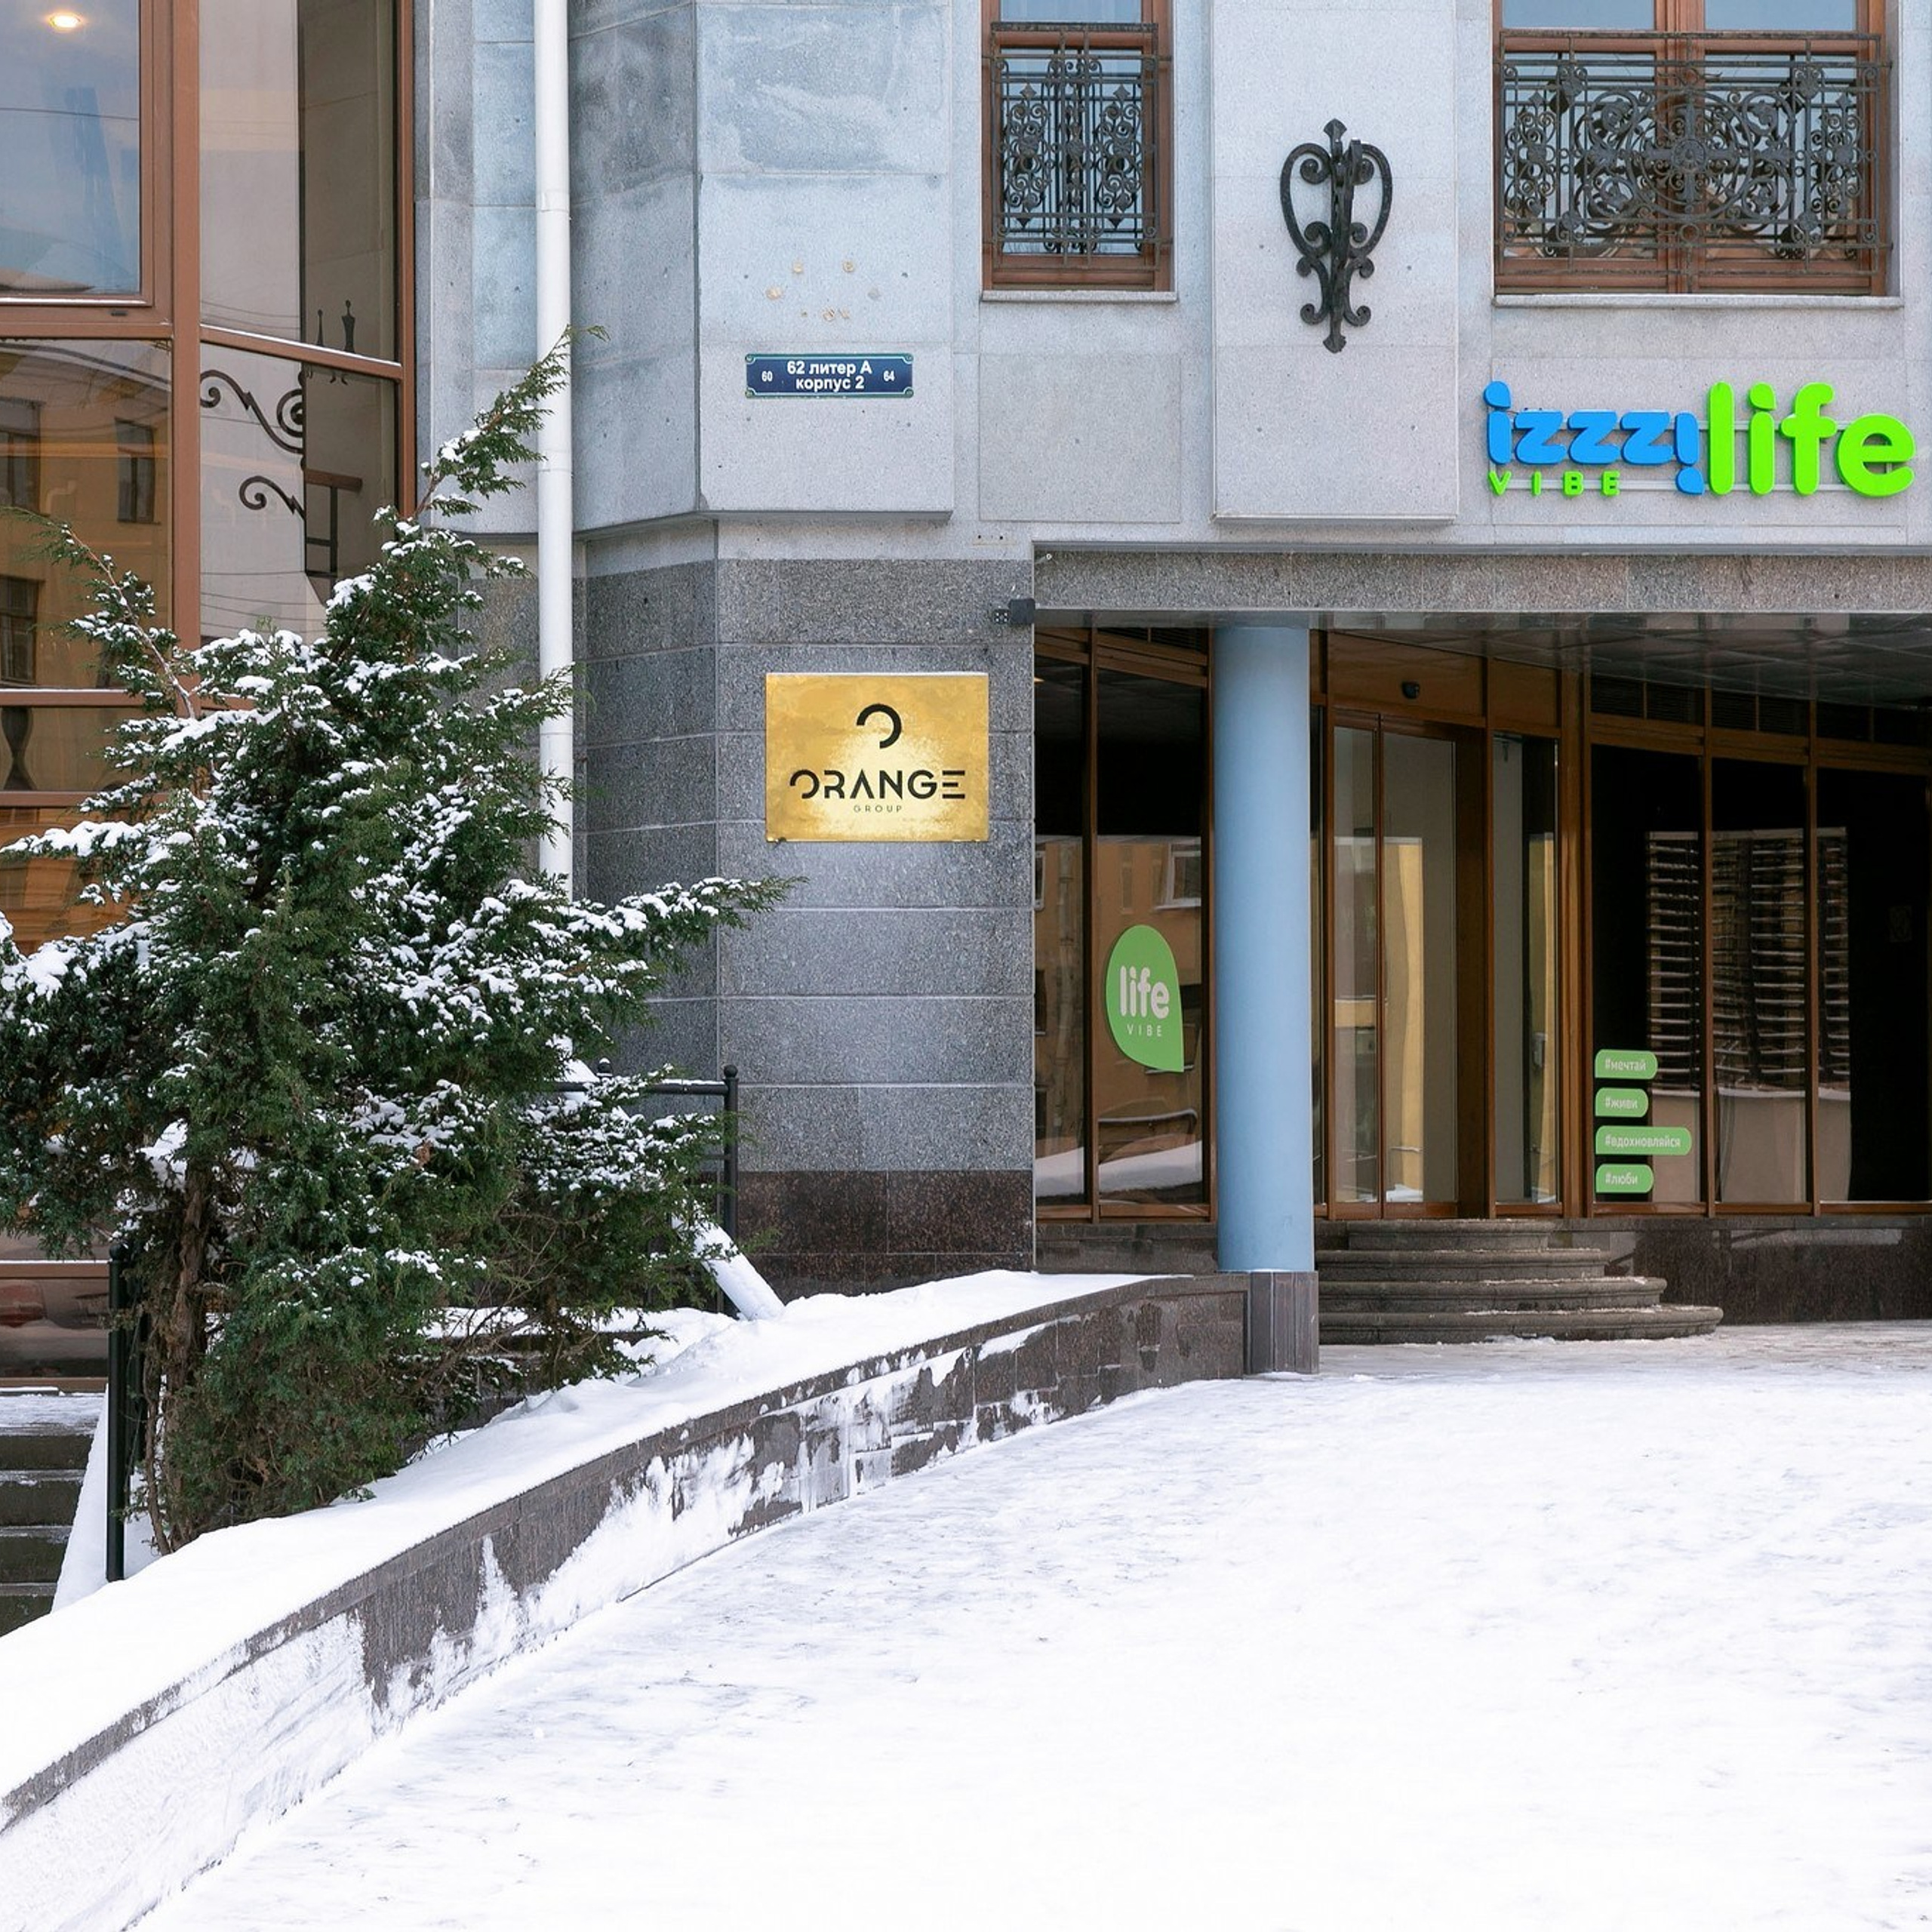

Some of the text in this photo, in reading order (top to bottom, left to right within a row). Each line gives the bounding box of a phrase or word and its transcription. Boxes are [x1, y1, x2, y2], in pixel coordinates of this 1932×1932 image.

[787, 361, 805, 374] 62
[809, 363, 855, 375] литер
[761, 371, 773, 382] 60
[883, 371, 894, 382] 64
[796, 376, 865, 392] корпус 2
[1707, 381, 1918, 498] life
[1487, 470, 1620, 497] VIBE
[789, 769, 965, 799] ORANGE
[1120, 965, 1170, 1019] life
[1127, 1025, 1162, 1037] VIBE
[1604, 1059, 1646, 1072] #мечтай
[1605, 1097, 1638, 1109] #живи
[1605, 1134, 1681, 1150] #вдохновляйся
[1605, 1172, 1638, 1185] #люби
